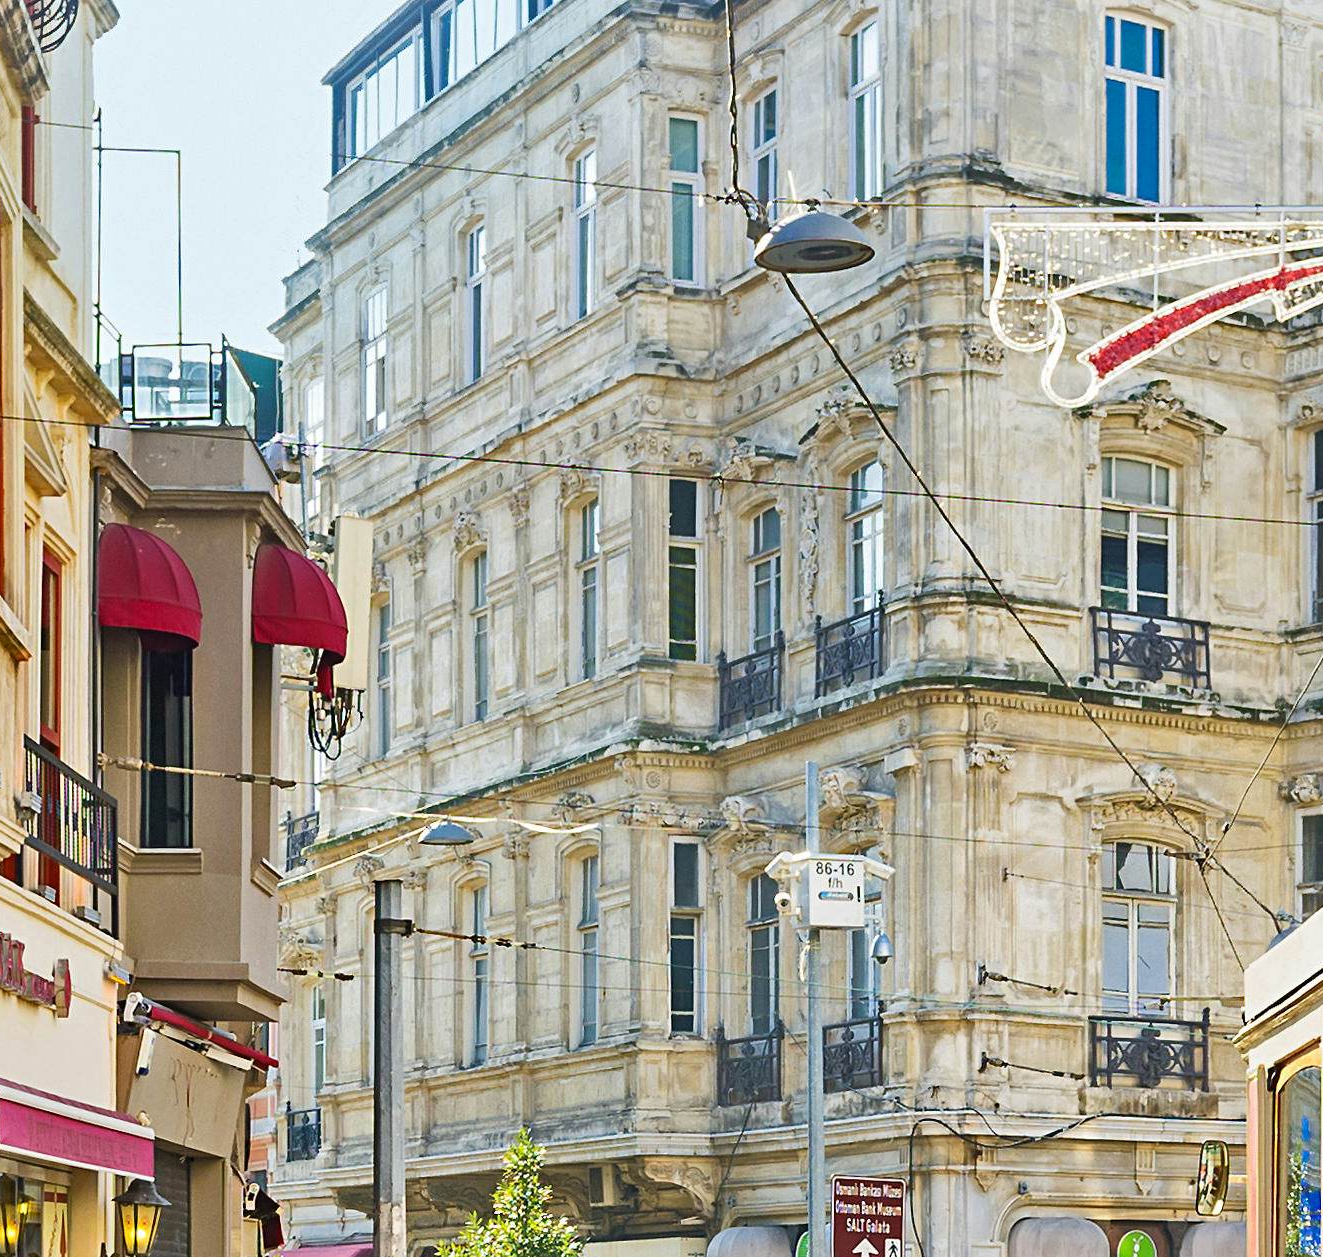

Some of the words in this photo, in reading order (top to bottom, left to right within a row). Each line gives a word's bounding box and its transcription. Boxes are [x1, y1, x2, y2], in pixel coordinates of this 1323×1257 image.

[816, 862, 855, 876] 86-16
[846, 1218, 865, 1232] SALT
[866, 1218, 890, 1234] Galata
